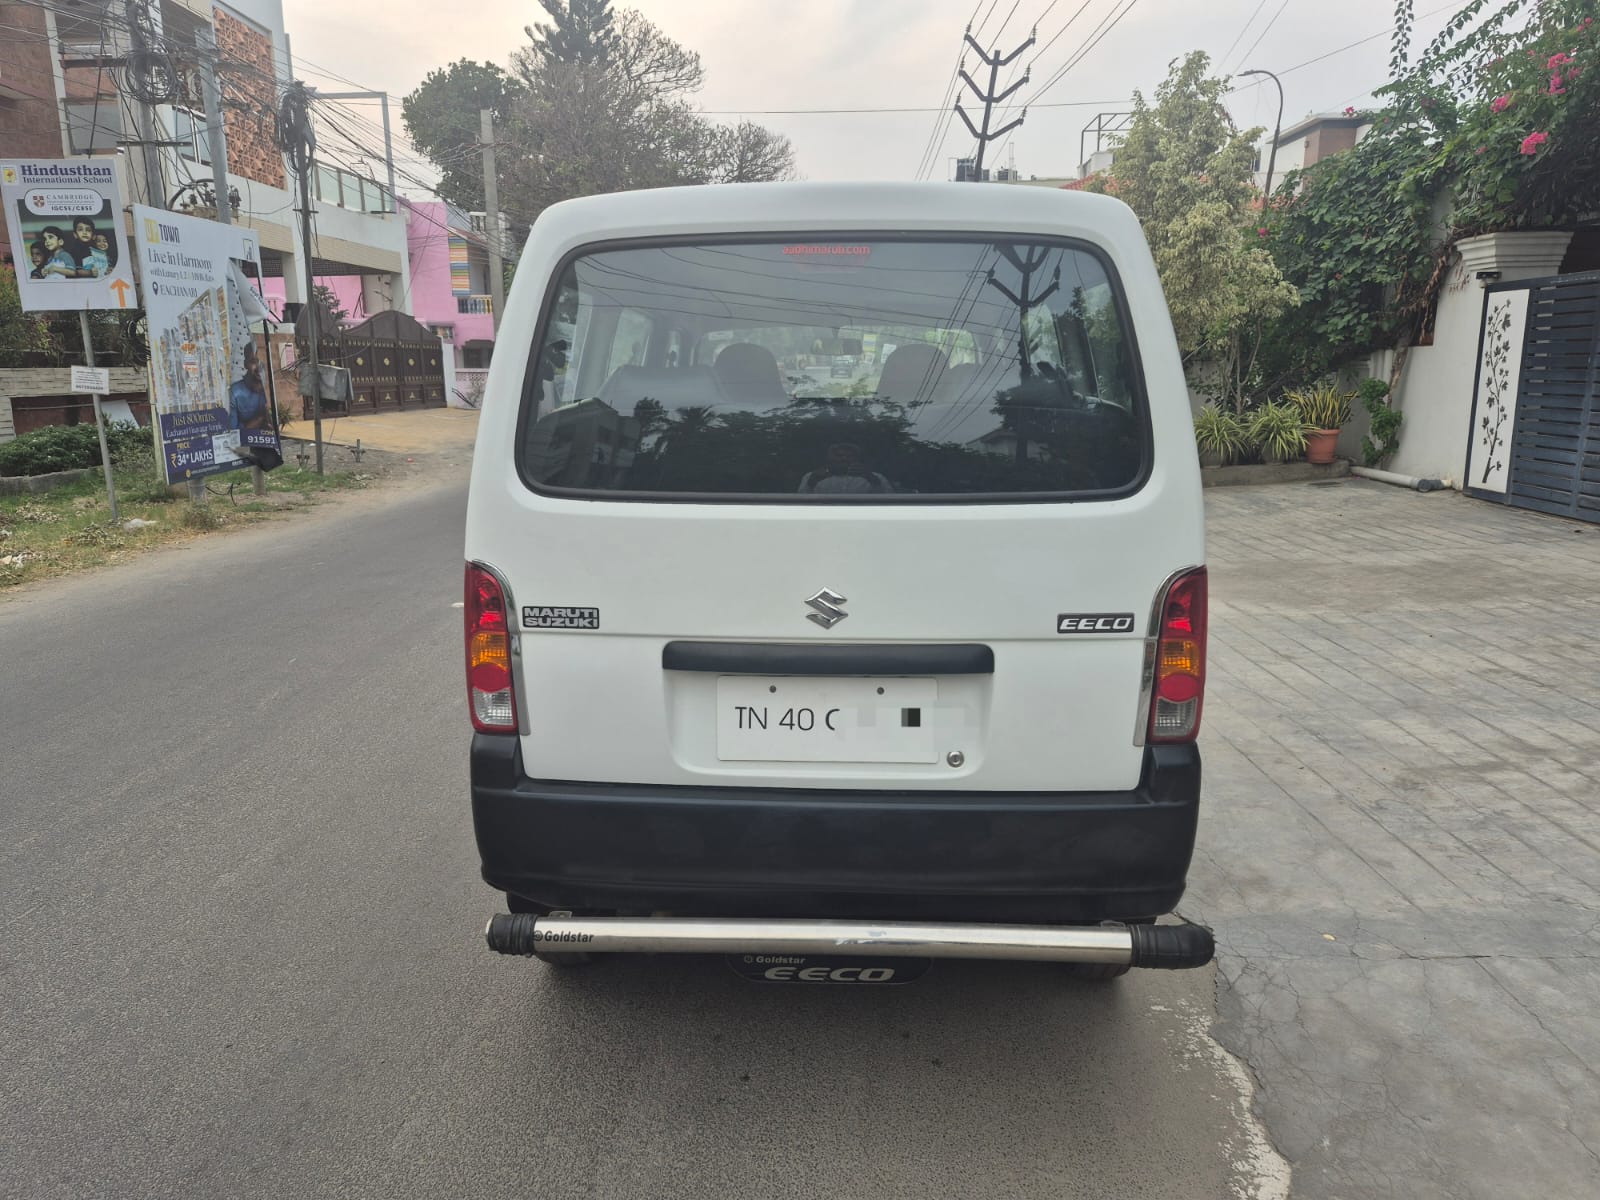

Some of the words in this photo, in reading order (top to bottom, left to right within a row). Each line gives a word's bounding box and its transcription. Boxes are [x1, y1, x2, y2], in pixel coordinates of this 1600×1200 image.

[21, 164, 112, 176] Hindusthan
[148, 247, 167, 263] Live
[167, 252, 176, 264] in
[177, 253, 212, 272] Harmony
[247, 435, 276, 444] 91591
[190, 449, 214, 463] LAKHS
[524, 607, 598, 618] MARUTI
[524, 617, 598, 628] SUZUKI
[1060, 617, 1132, 630] EECO
[735, 706, 768, 730] TN
[779, 708, 815, 731] 40
[544, 930, 594, 943] Goldstar
[756, 955, 806, 964] Goldstar
[764, 967, 895, 982] EECO
